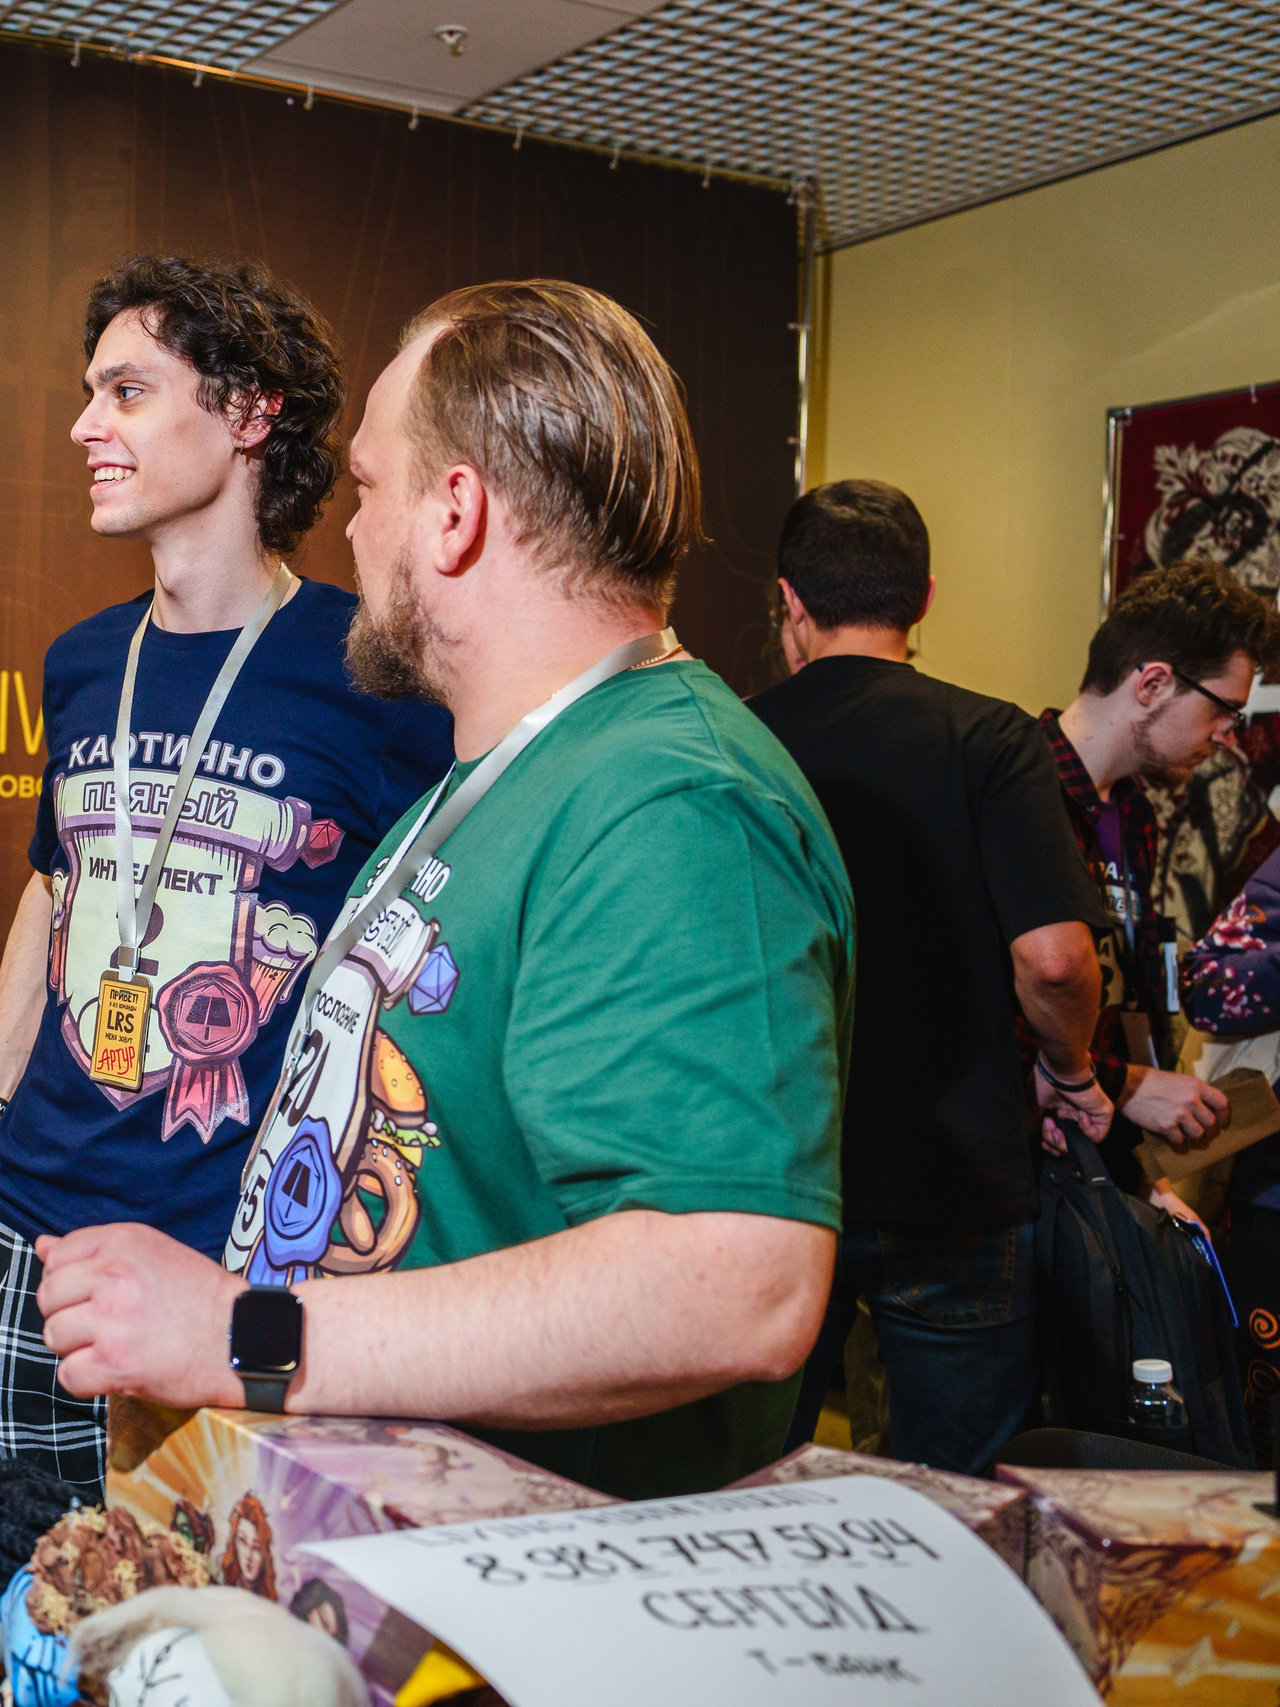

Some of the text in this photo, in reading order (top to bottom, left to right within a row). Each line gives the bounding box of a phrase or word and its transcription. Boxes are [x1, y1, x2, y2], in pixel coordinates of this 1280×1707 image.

[109, 989, 139, 1004] ПРИВЕТ!
[107, 1009, 135, 1034] LRS
[118, 1034, 133, 1045] ЗОВУТ
[97, 1045, 136, 1076] АРТУР
[464, 1552, 527, 1587] 8
[526, 1539, 656, 1582] 981
[639, 1528, 771, 1567] 747
